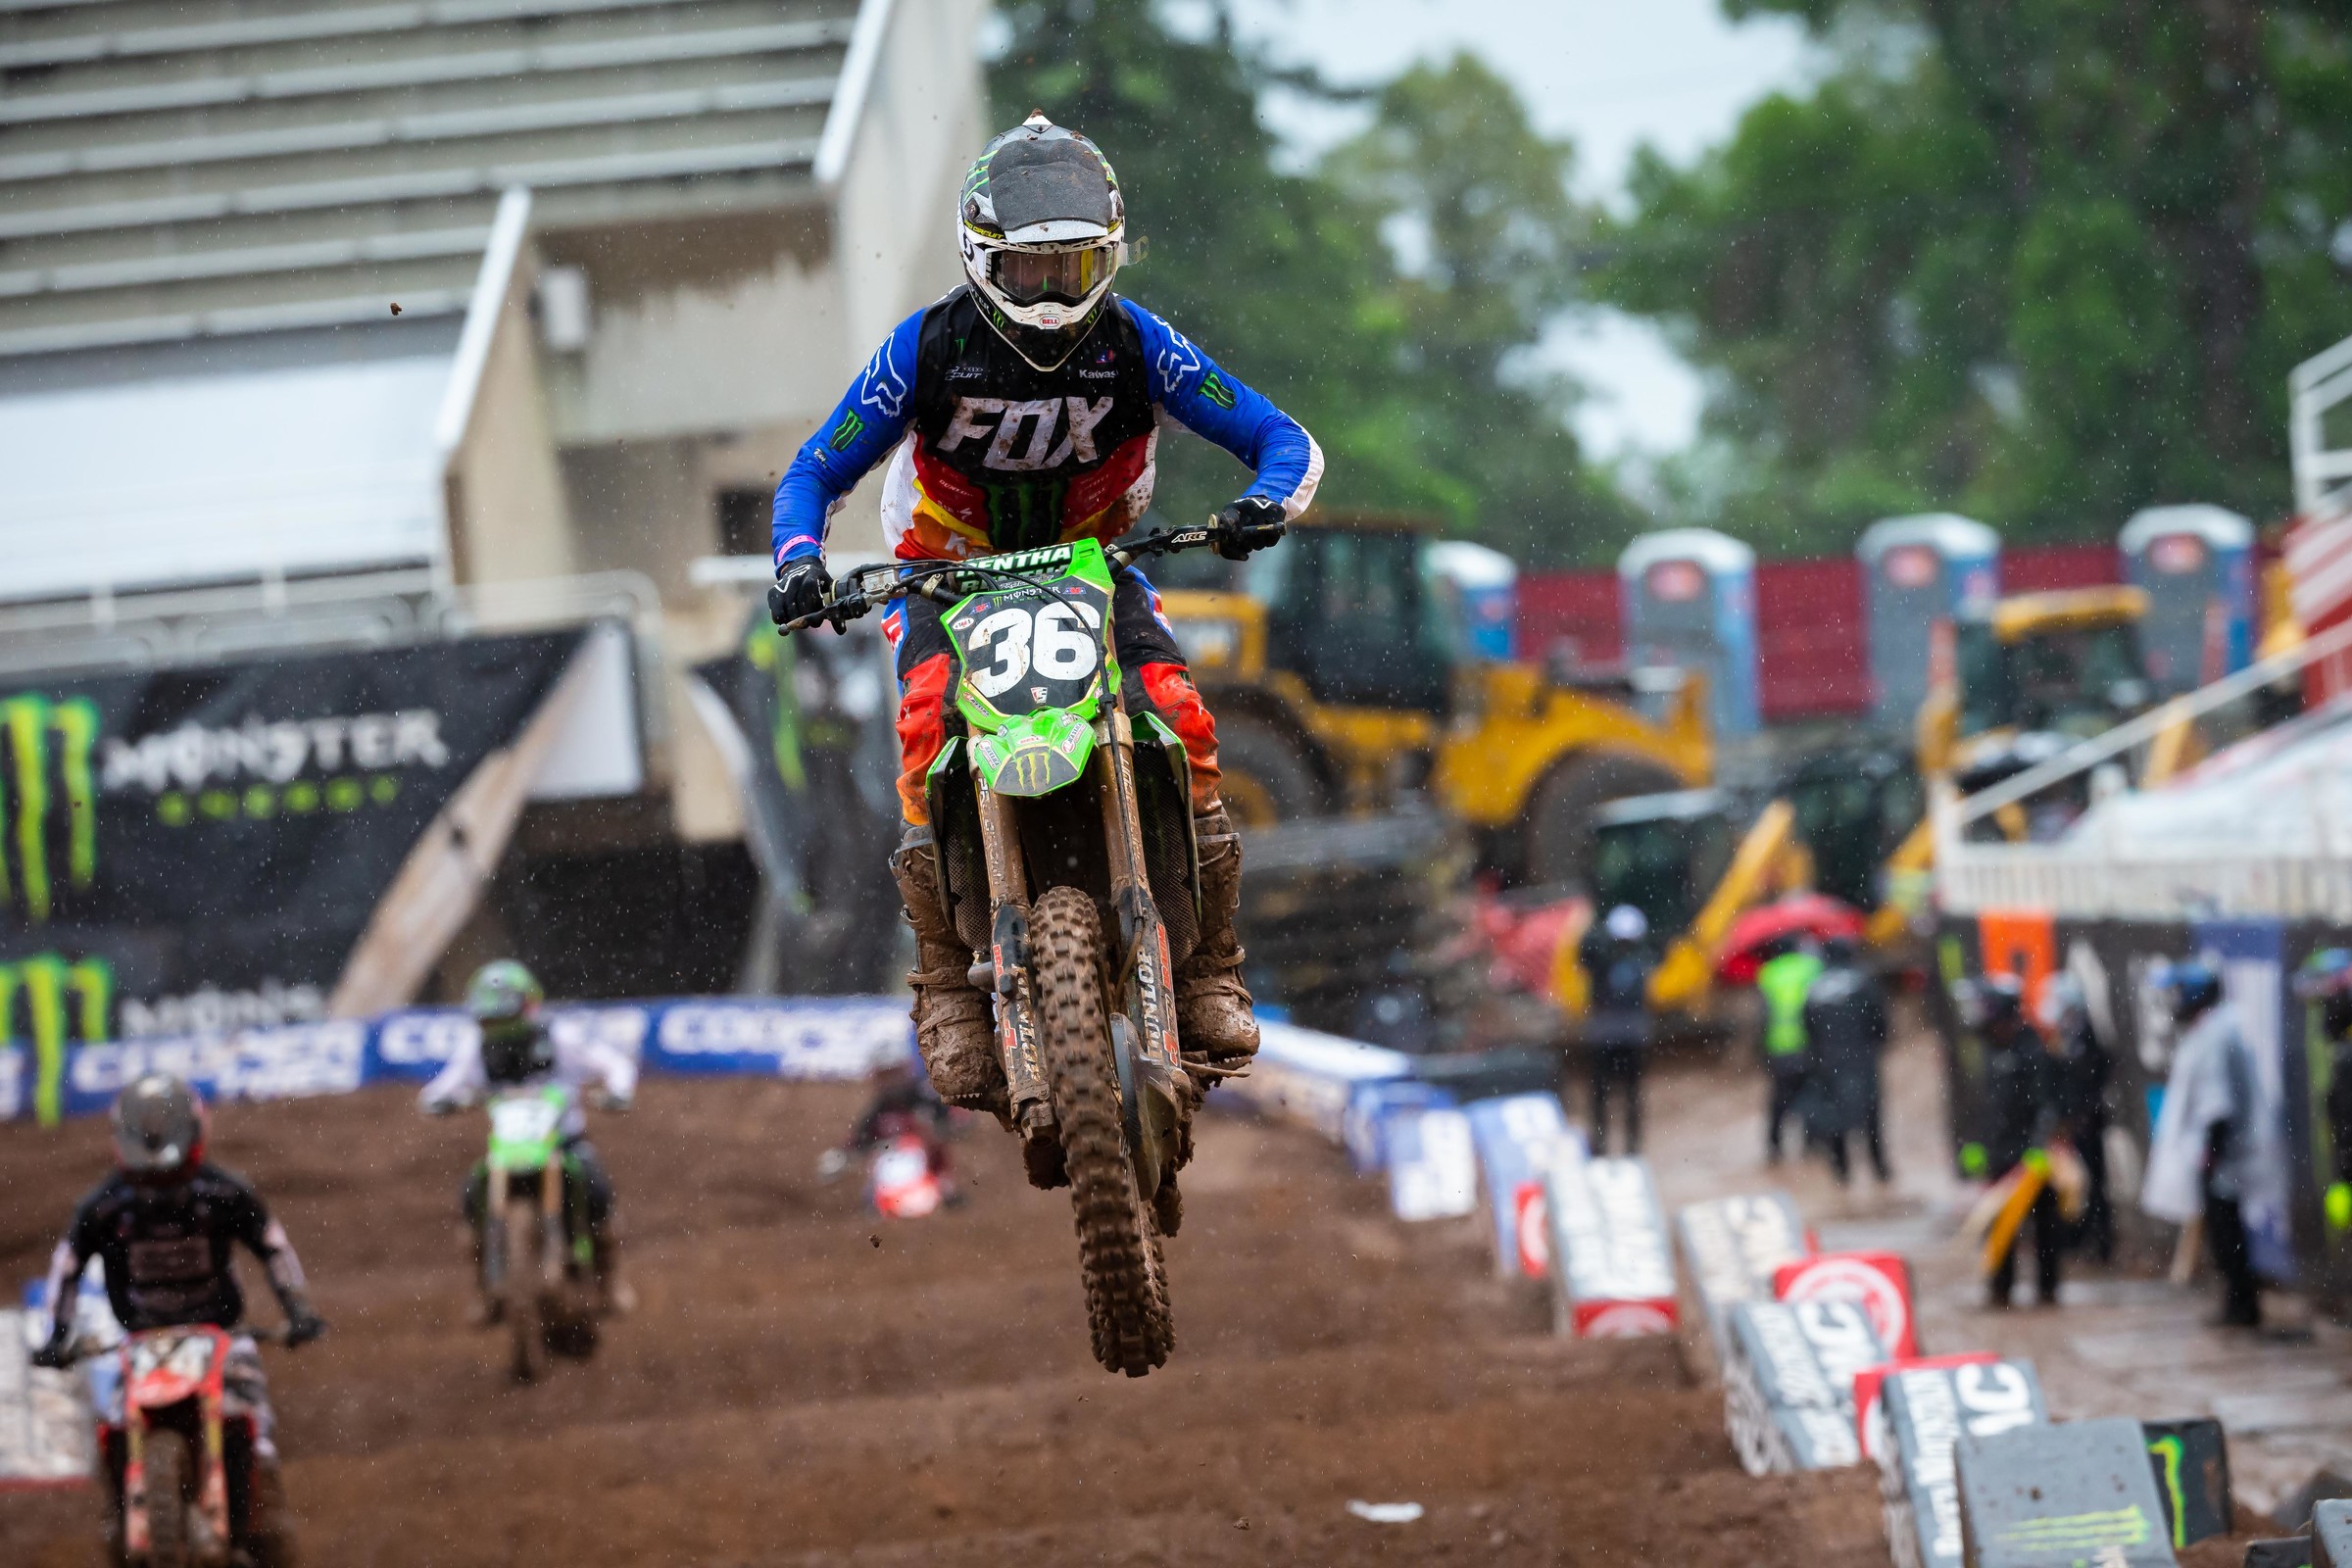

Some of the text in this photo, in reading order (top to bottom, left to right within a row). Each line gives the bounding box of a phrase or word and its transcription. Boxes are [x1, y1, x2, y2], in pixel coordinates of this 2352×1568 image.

[936, 396, 1113, 471] FOX
[956, 546, 1072, 578] RENTHA
[1171, 530, 1207, 544] ARC
[1003, 586, 1061, 602] MONSTR
[967, 601, 1101, 698] 36
[103, 710, 449, 792] MONSTER
[1137, 944, 1164, 1059] DUNLOP
